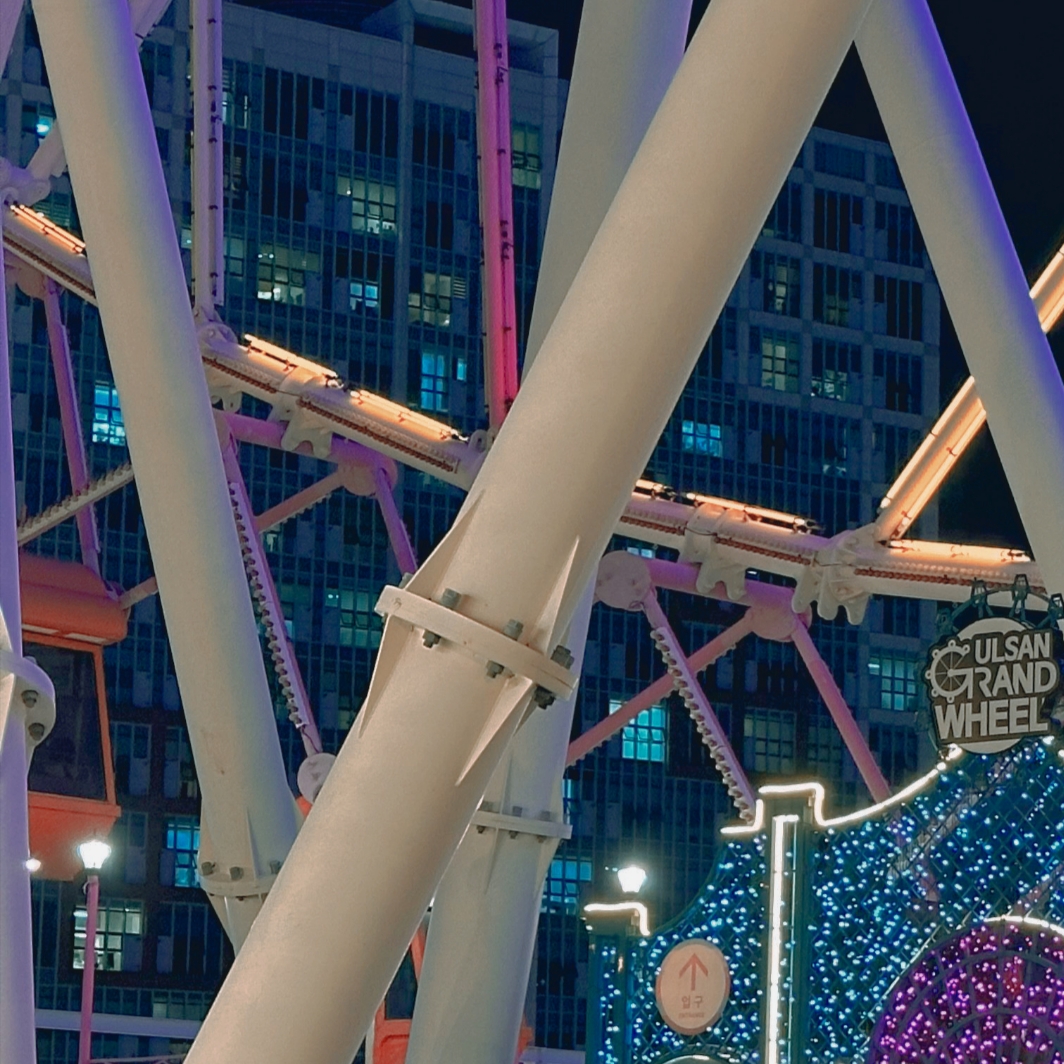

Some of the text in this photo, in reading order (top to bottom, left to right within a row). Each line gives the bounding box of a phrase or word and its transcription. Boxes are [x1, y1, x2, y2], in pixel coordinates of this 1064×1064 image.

[975, 632, 1050, 664] ULSAN
[925, 640, 1057, 703] GRAND
[935, 697, 1048, 739] WHEEL
